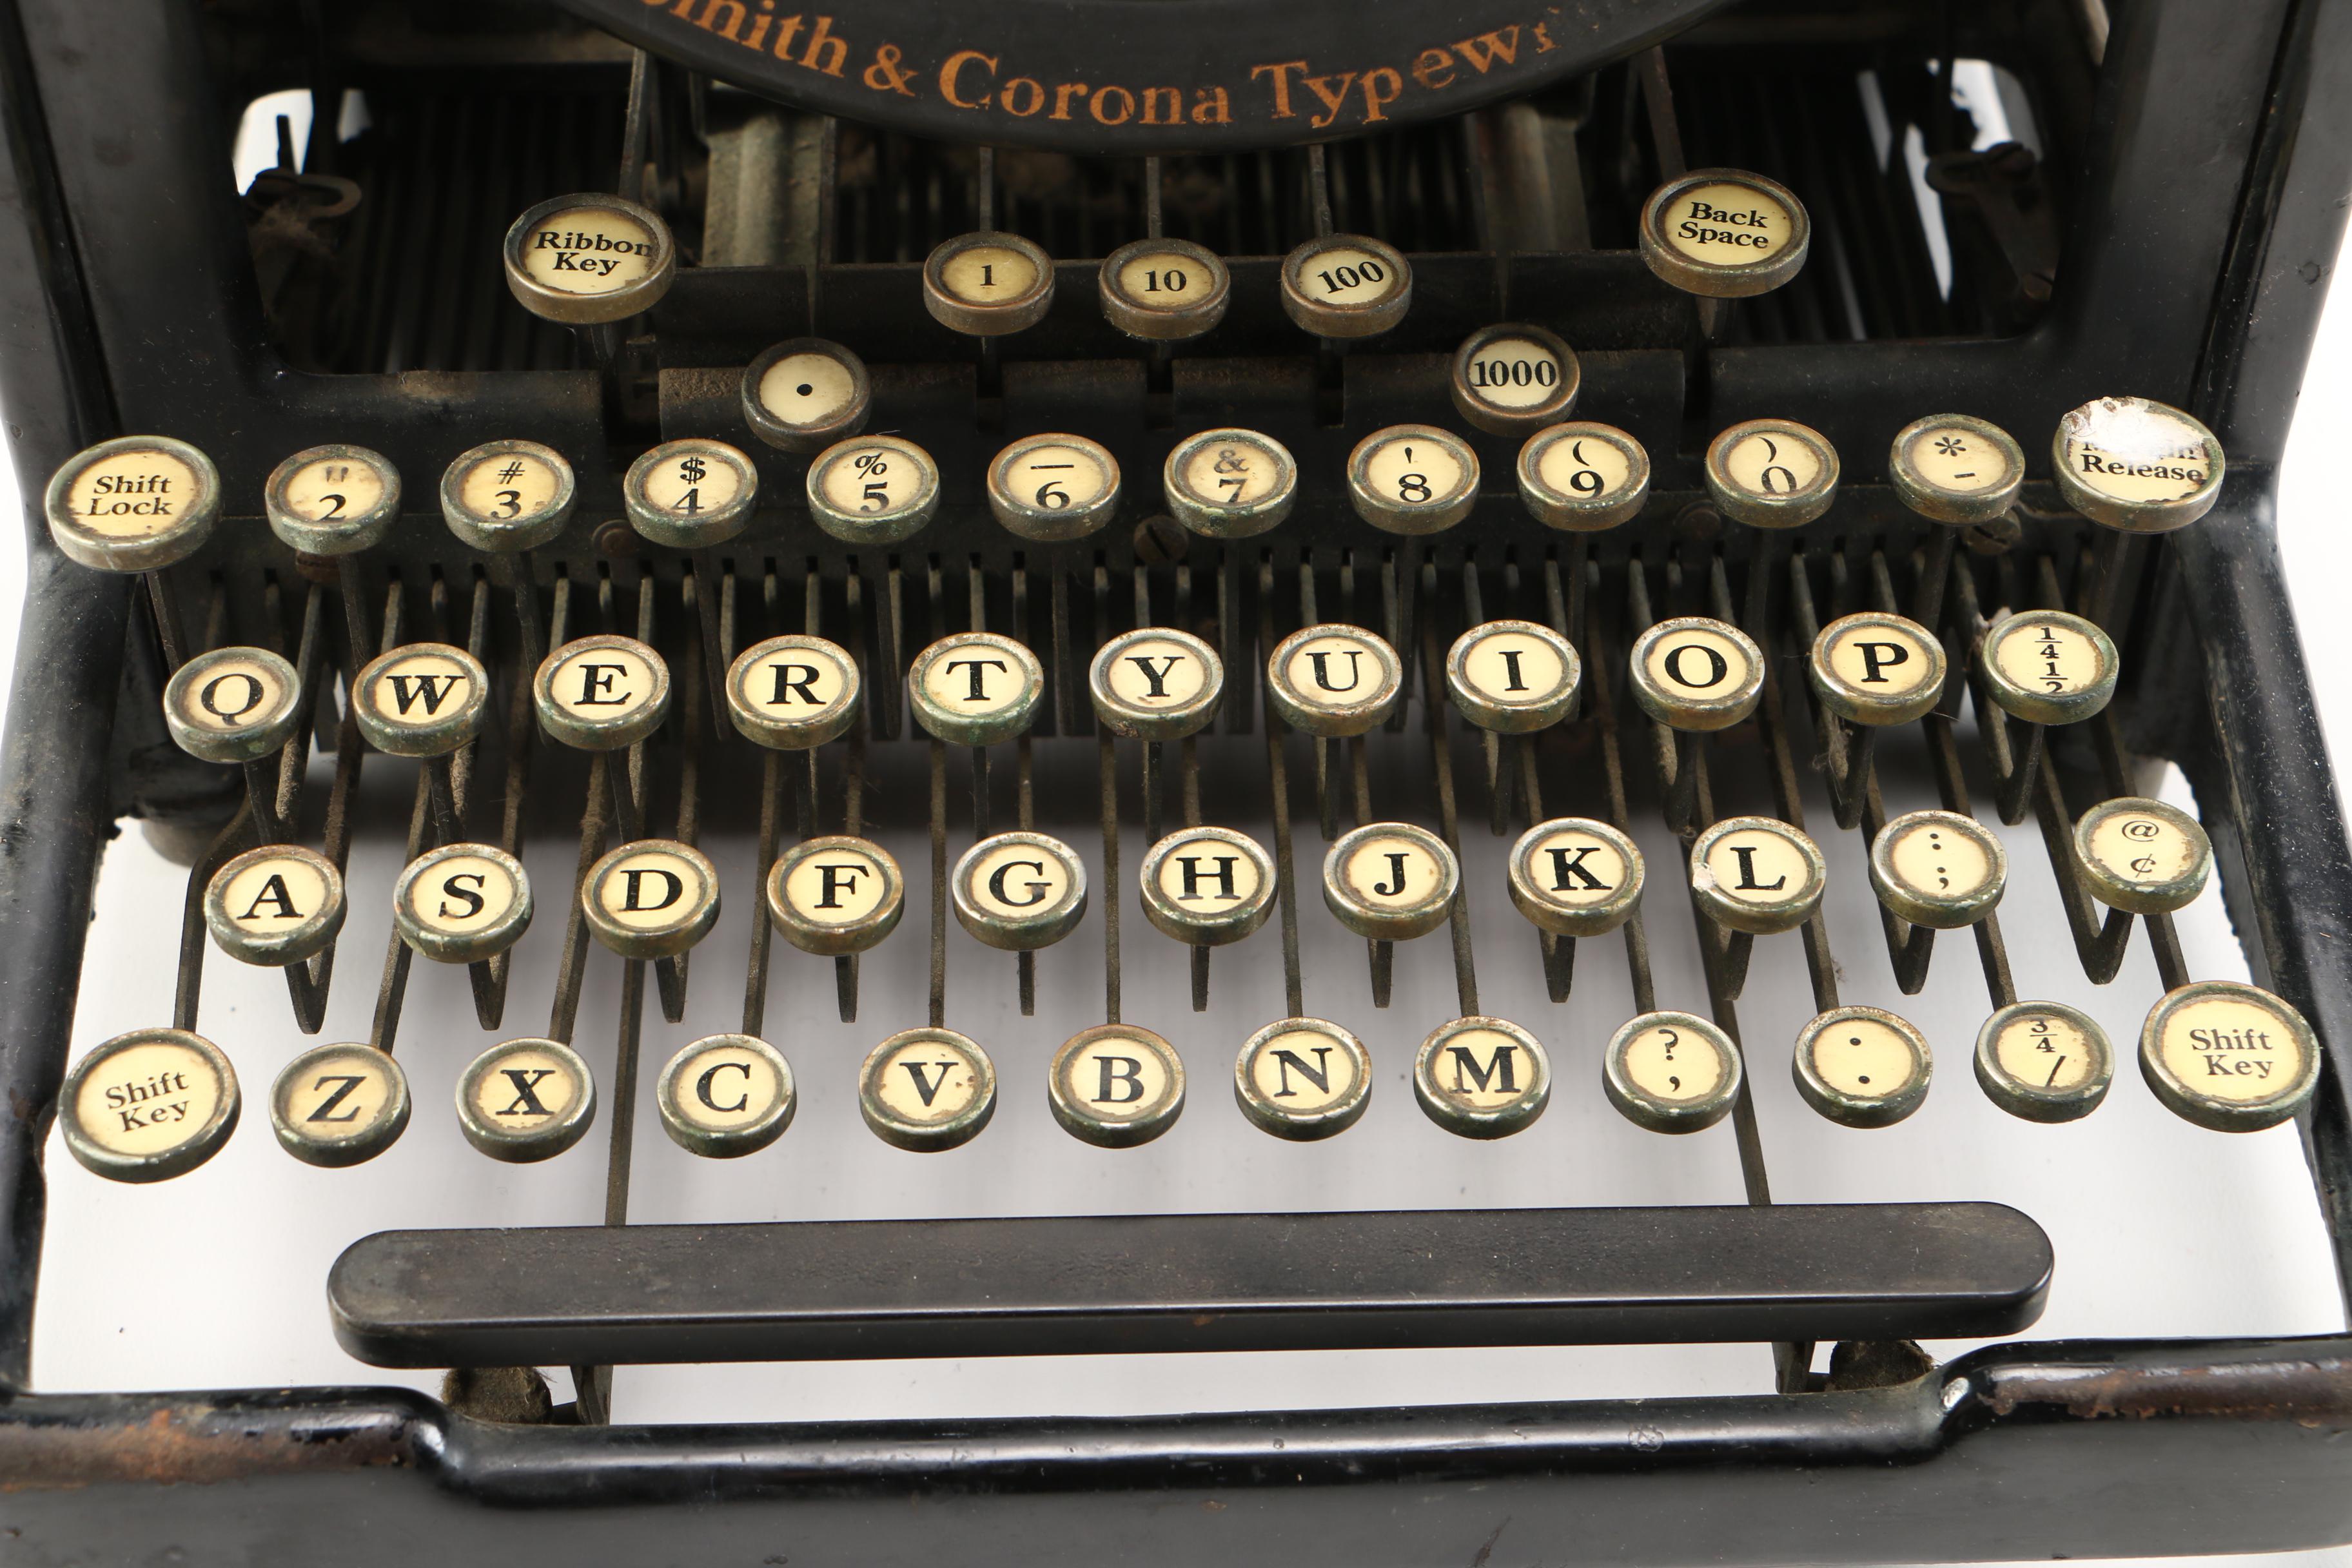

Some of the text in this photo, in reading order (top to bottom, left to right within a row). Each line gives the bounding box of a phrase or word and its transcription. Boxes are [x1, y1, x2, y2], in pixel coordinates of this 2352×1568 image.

[863, 44, 919, 97] &
[939, 50, 1232, 125] Corona
[1678, 222, 1769, 248] Space
[1689, 202, 1767, 228] Back
[534, 231, 651, 258] Ribbon
[553, 252, 621, 276] Key
[1144, 270, 1187, 292] 10
[1317, 260, 1384, 294] 100
[1474, 360, 1557, 387] 1000
[680, 456, 707, 485] $
[854, 453, 887, 480] %
[1213, 449, 1250, 475] &
[93, 475, 171, 495] Shift
[491, 489, 522, 518] 3
[671, 487, 705, 515] 4
[859, 482, 890, 514] 5
[1035, 481, 1071, 509] 6
[1219, 478, 1248, 503] 7
[1396, 472, 1434, 504] 8
[1569, 470, 1605, 498] 9
[88, 497, 173, 518] Lock
[318, 494, 347, 520] 2
[946, 660, 1008, 701] T
[1124, 656, 1186, 698] Y
[1305, 651, 1364, 692] U
[1498, 650, 1531, 692] I
[1664, 643, 1728, 689] O
[1852, 642, 1909, 683] P
[201, 673, 265, 725] Q
[386, 674, 466, 716] W
[573, 663, 632, 706] E
[766, 664, 827, 705] R
[2122, 819, 2160, 842] @
[814, 864, 870, 910] F
[988, 860, 1053, 906] G
[1175, 856, 1241, 901] H
[1373, 853, 1411, 897] J
[1544, 846, 1612, 891] K
[1730, 847, 1787, 890] L
[237, 874, 304, 919] A
[438, 874, 485, 920] S
[618, 868, 683, 912] D
[1658, 1028, 1680, 1062] ?
[2189, 1028, 2274, 1051] Shift
[897, 1061, 959, 1108] V
[1090, 1055, 1145, 1104] B
[1269, 1046, 1333, 1098] N
[1446, 1045, 1522, 1095] M
[2202, 1054, 2275, 1079] Key
[105, 1072, 190, 1110] Shift
[306, 1076, 367, 1122] Z
[495, 1069, 556, 1116] X
[696, 1062, 751, 1113] C
[119, 1100, 190, 1133] Key
